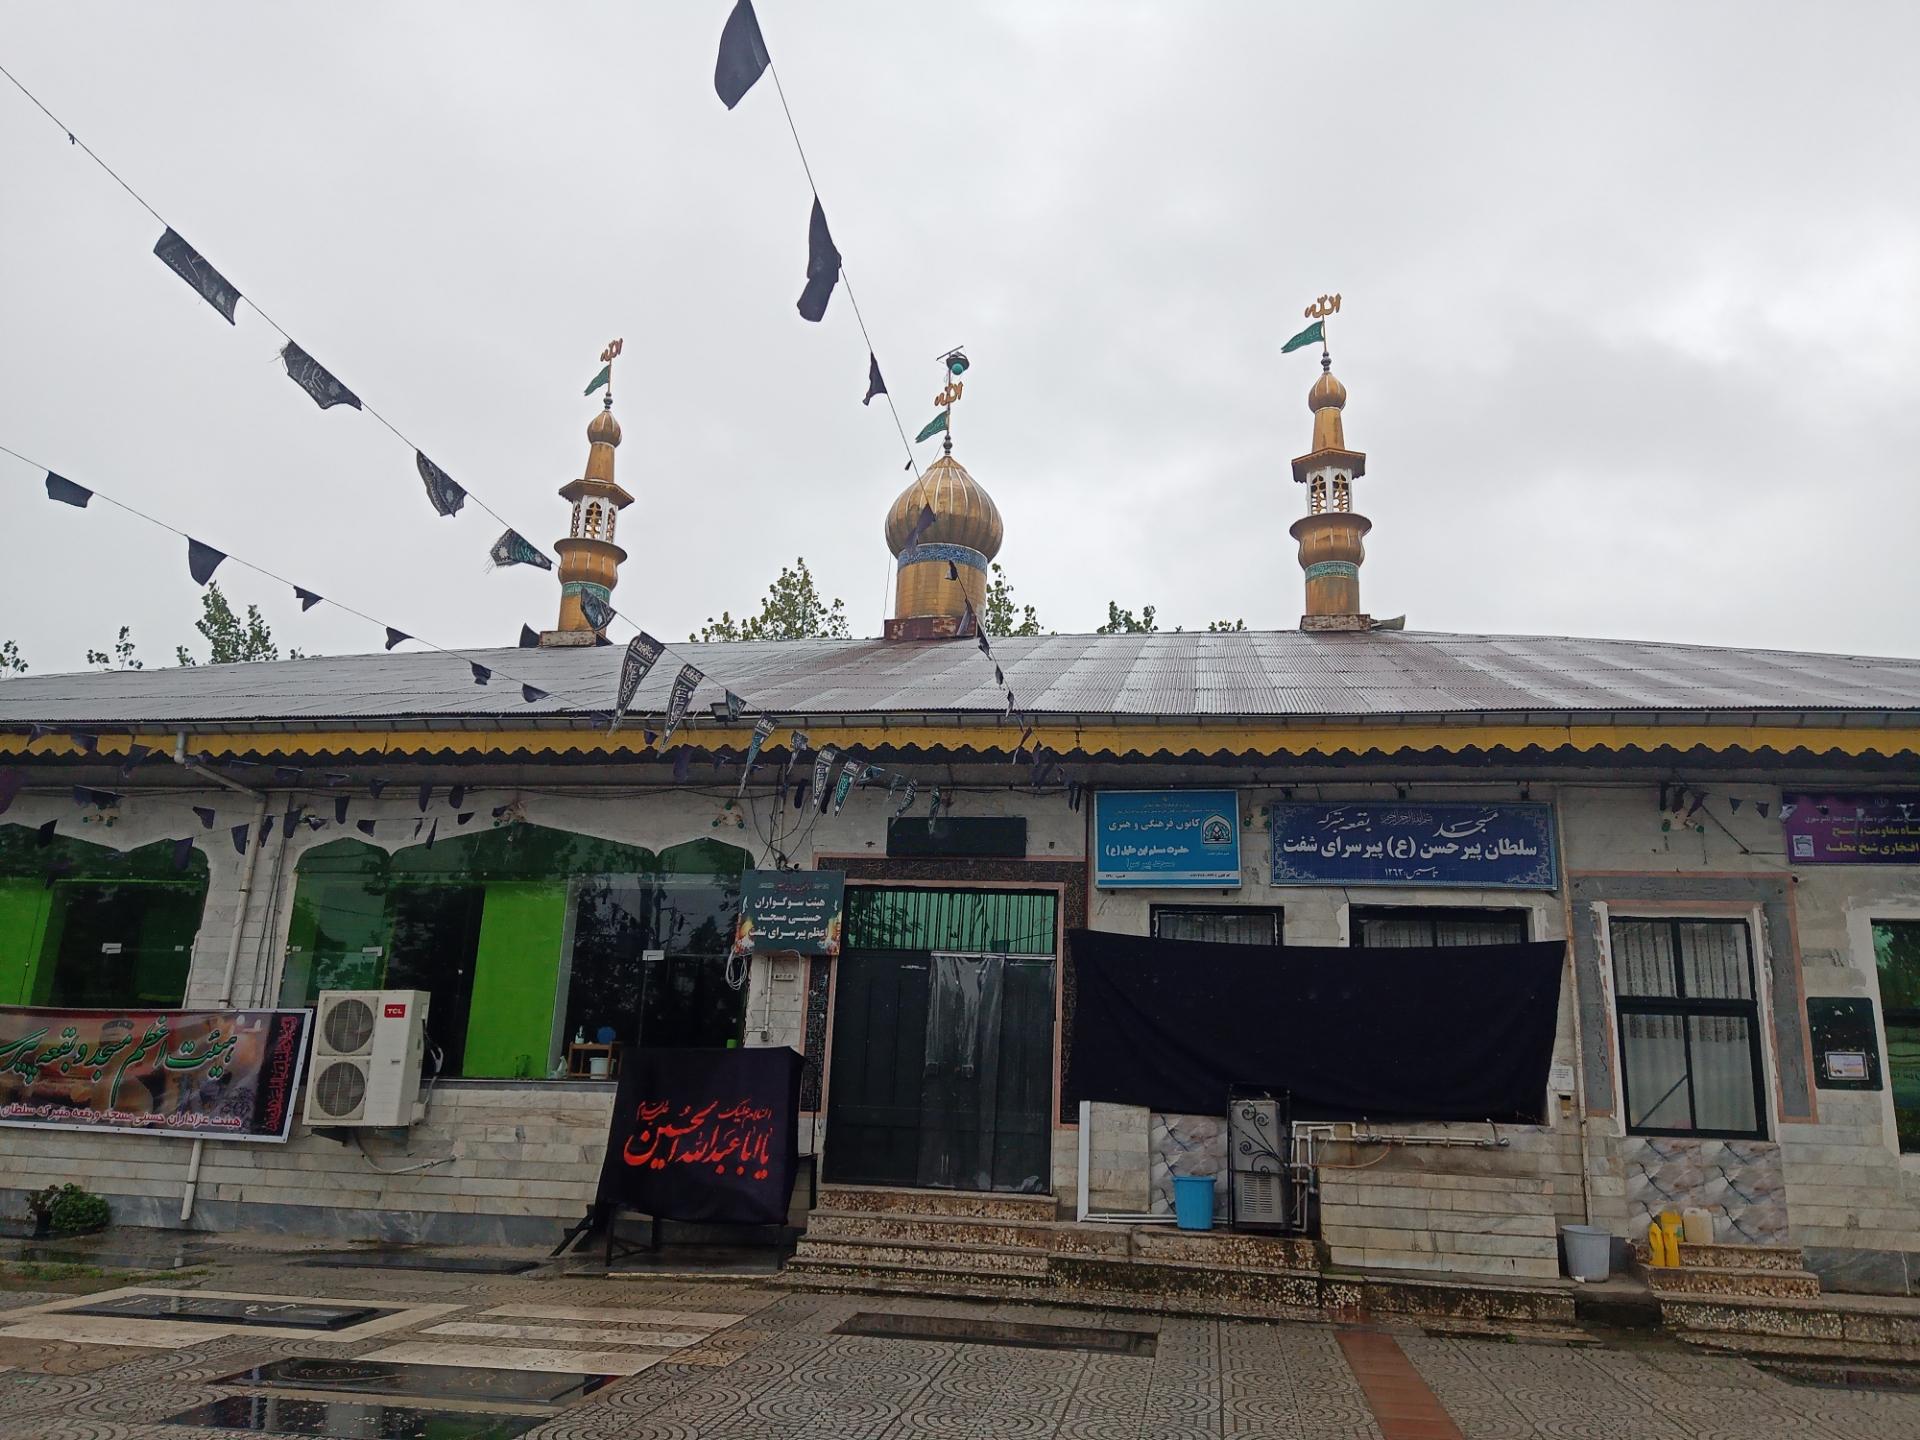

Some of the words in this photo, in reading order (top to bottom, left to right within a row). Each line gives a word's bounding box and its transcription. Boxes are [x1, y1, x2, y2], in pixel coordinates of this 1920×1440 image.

[1107, 822, 1132, 832] هنری
[1133, 823, 1139, 832] و
[1140, 818, 1174, 832] فرهنگی
[1175, 817, 1201, 831] کانون
[1432, 807, 1500, 839] مسجد
[1283, 835, 1319, 855] شفت
[1386, 835, 1417, 859] (ع)
[1420, 839, 1461, 861] حسن
[1459, 841, 1486, 862] پیر
[1485, 837, 1538, 861] سلطان
[754, 896, 805, 910] سوگواران
[757, 912, 787, 924] مسجد
[788, 911, 822, 924] حسینی
[749, 926, 767, 938] شفت
[807, 926, 829, 940] اعظم
[36, 1026, 80, 1075] بقعه
[73, 1043, 89, 1065] و
[84, 1034, 133, 1083] مسجد
[0, 1102, 37, 1118] سلطان
[91, 1110, 102, 1124] و
[102, 1107, 135, 1124] مسجد
[167, 1111, 210, 1129] عزاداران
